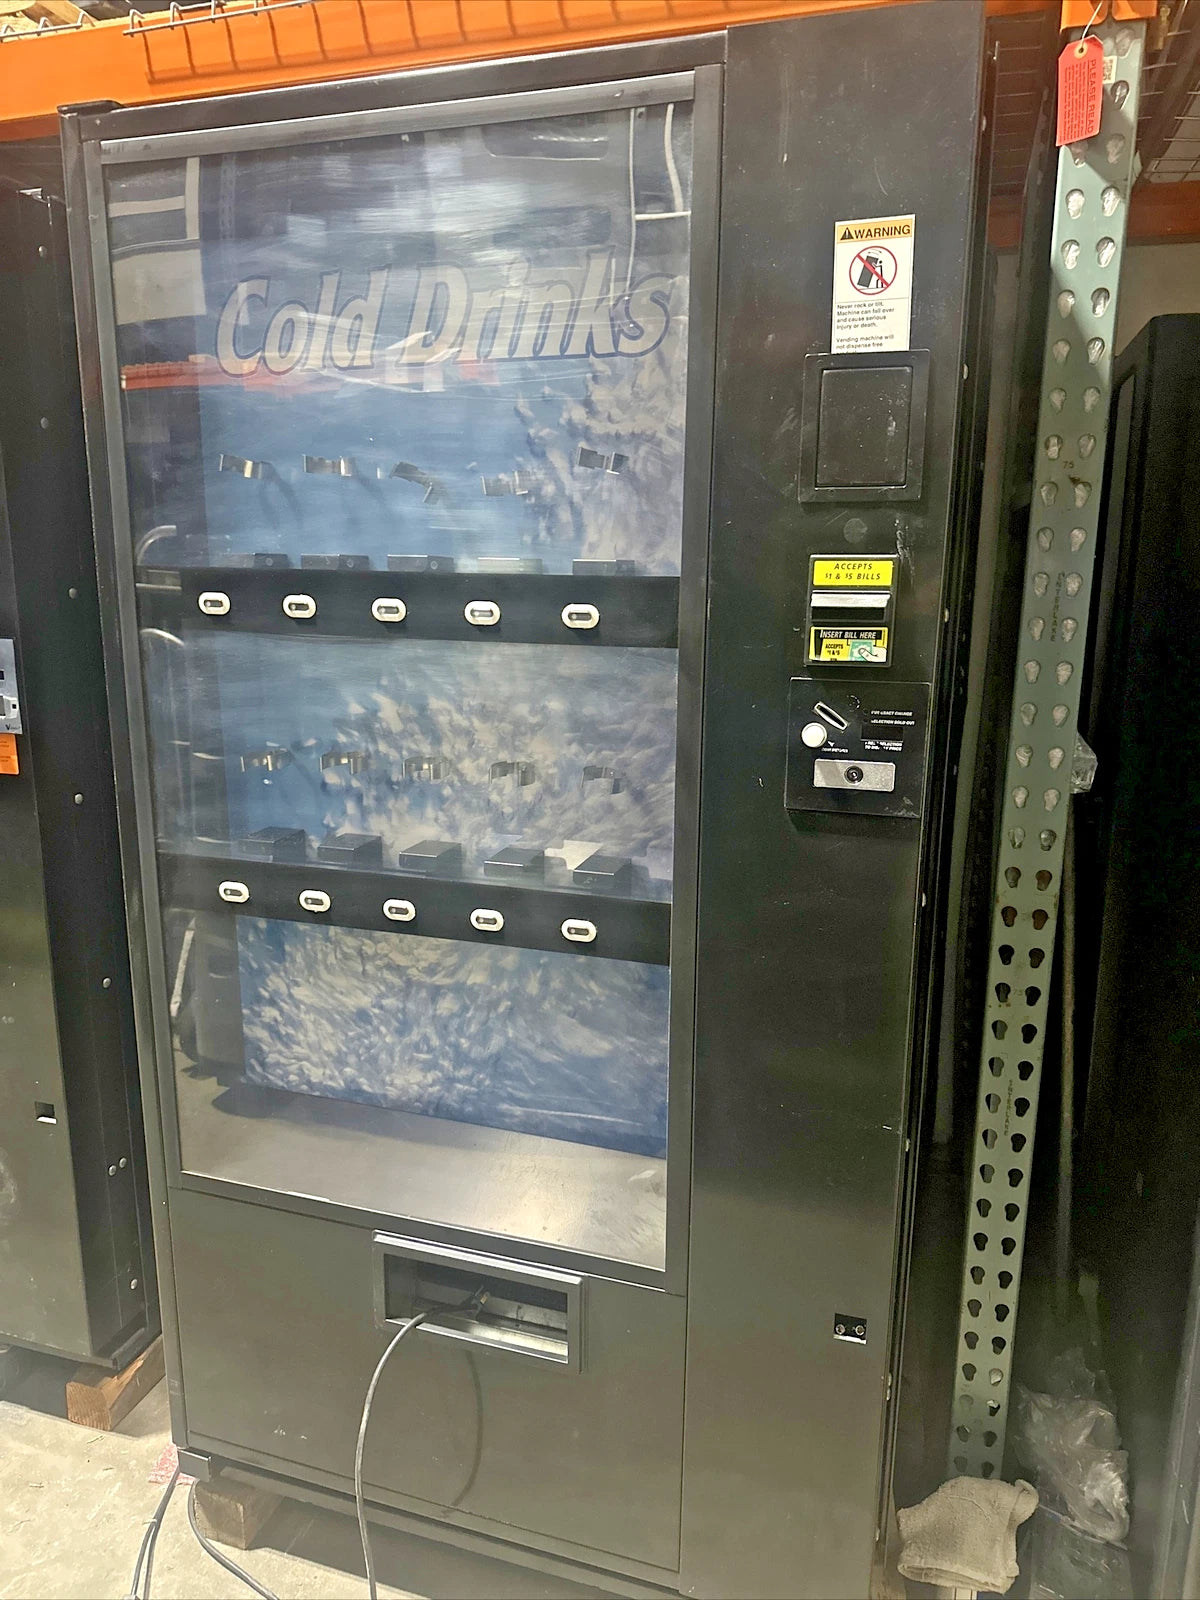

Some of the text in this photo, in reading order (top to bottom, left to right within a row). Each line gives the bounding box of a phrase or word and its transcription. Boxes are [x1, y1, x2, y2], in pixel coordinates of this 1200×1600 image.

[1087, 59, 1097, 133] PLEASE READ
[854, 224, 911, 239] WARNING
[215, 245, 678, 379] Cold Drinks
[845, 572, 853, 580] $5
[820, 629, 844, 638] INSERT
[844, 631, 857, 639] BILL
[859, 631, 877, 639] HERE
